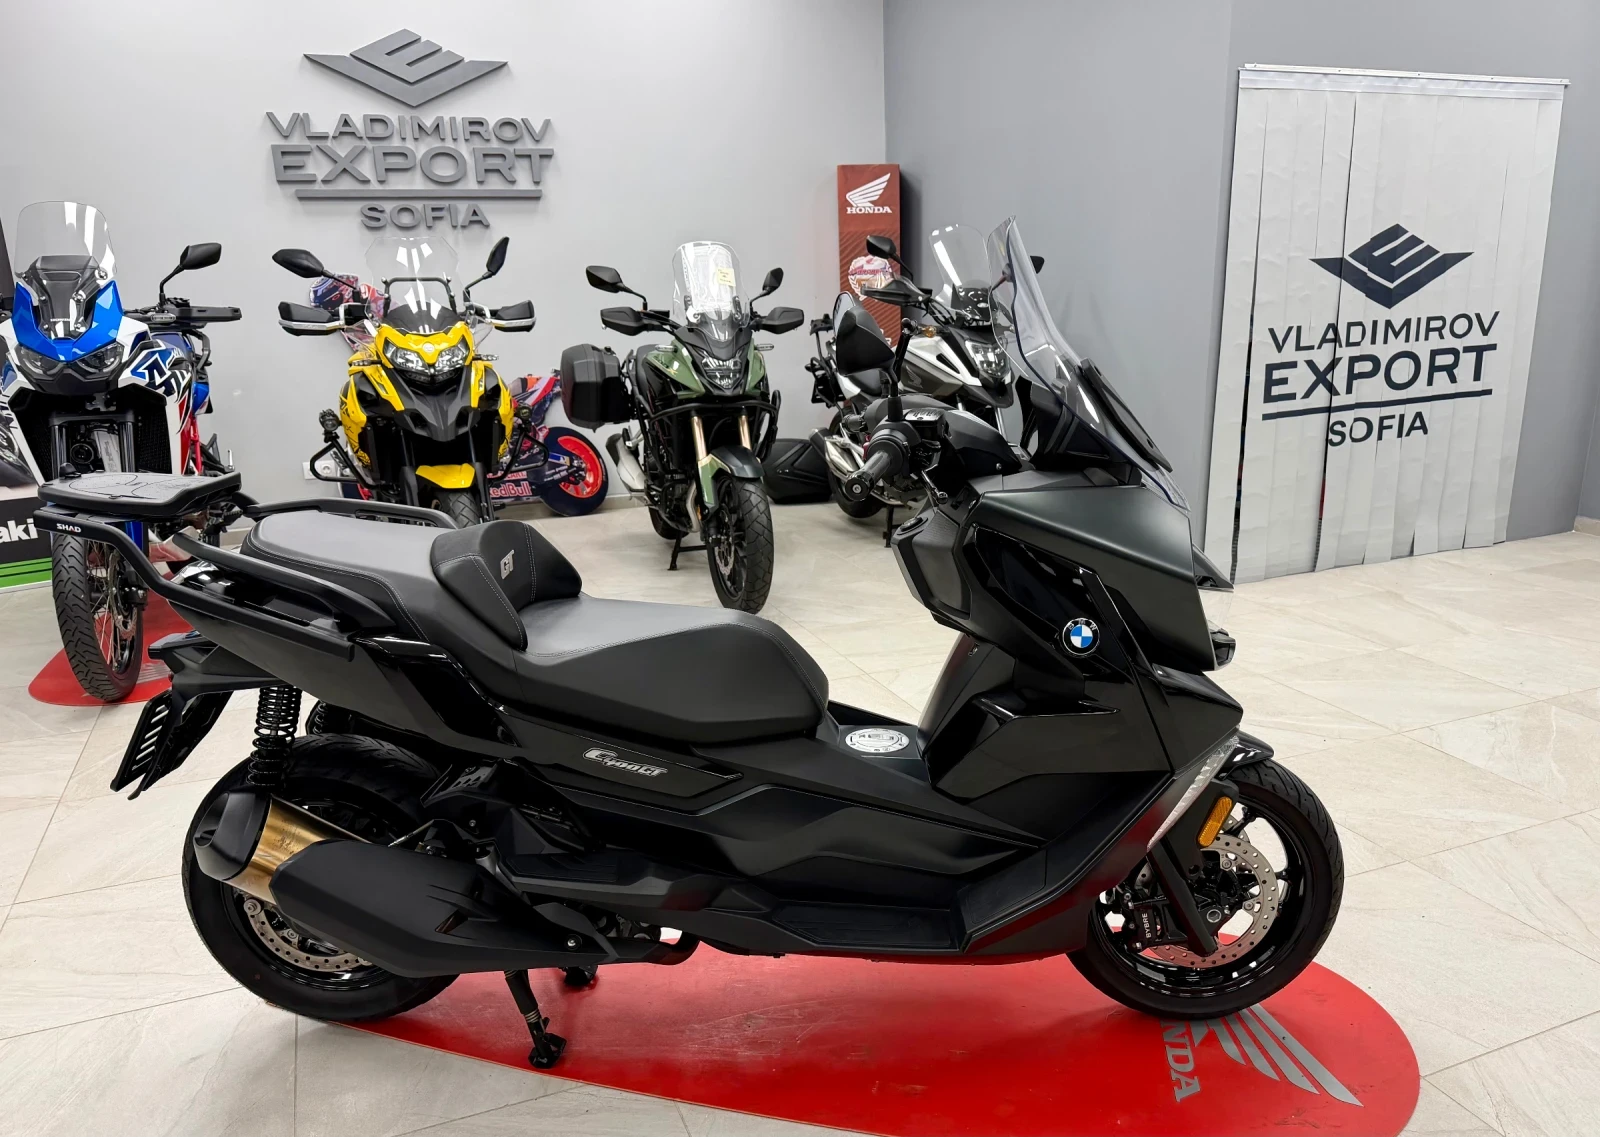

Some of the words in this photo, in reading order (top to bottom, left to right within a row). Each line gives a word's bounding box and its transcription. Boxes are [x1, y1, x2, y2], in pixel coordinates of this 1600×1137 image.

[265, 111, 552, 142] VLADIMIROV
[270, 143, 555, 184] EXPORT
[360, 203, 490, 229] SOFIA
[846, 206, 893, 215] HONDA
[1268, 311, 1500, 353] VLADIMIROV
[1262, 343, 1497, 404] EXPORT
[1328, 411, 1428, 446] SOFIA
[56, 523, 82, 533] SHAD
[500, 549, 515, 580] GT
[1141, 912, 1152, 939] BYBRE
[1160, 1020, 1201, 1103] NDA
